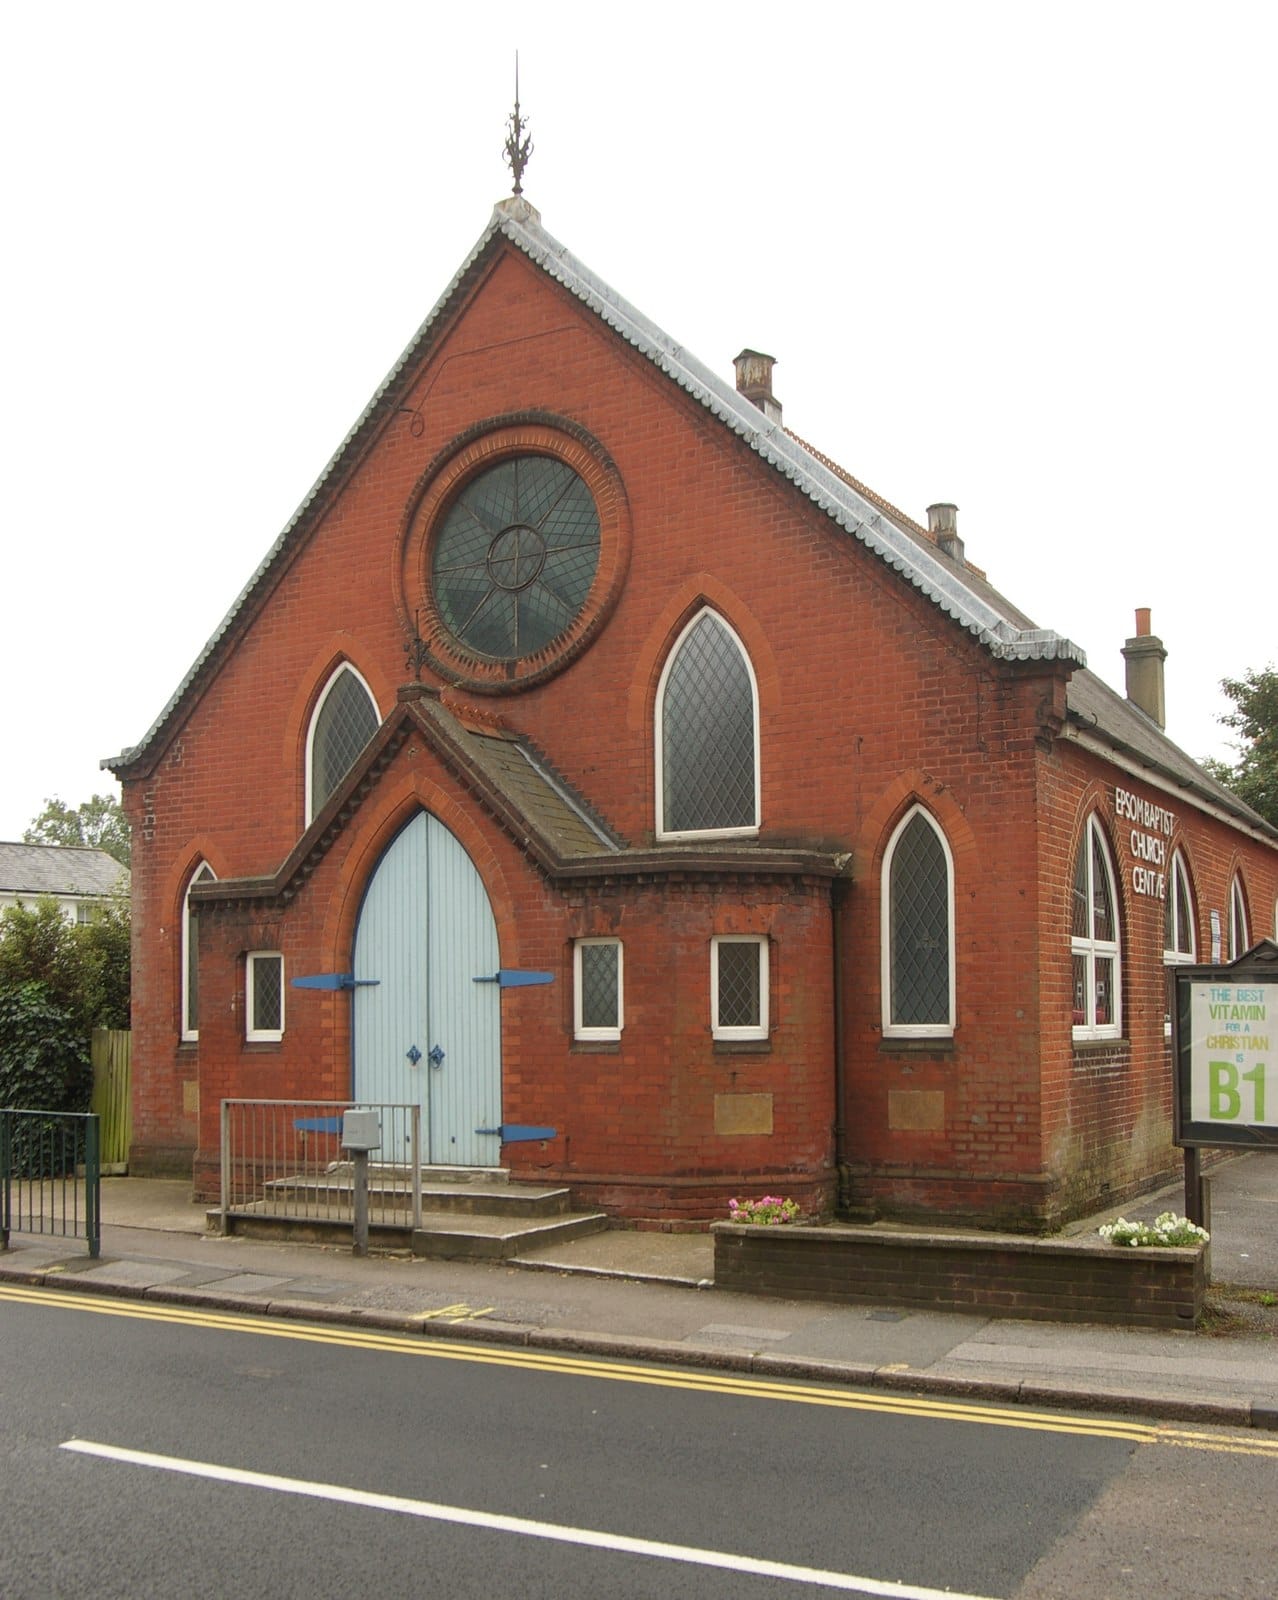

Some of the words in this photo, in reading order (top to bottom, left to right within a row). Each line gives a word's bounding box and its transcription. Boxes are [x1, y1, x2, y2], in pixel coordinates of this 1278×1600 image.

[1115, 787, 1144, 824] EPSOM
[1144, 801, 1175, 836] BAPTIST
[1130, 829, 1165, 866] CHURCH
[1132, 866, 1165, 899] CENTRE
[1209, 988, 1232, 1002] THE
[1236, 988, 1265, 1003] BEST
[1208, 1004, 1266, 1021] VITAMIN
[1225, 1022, 1241, 1032] FOR
[1244, 1023, 1251, 1033] A
[1206, 1034, 1269, 1051] CHRISTIAN
[1235, 1053, 1244, 1063] IS
[1208, 1061, 1265, 1122] B1
